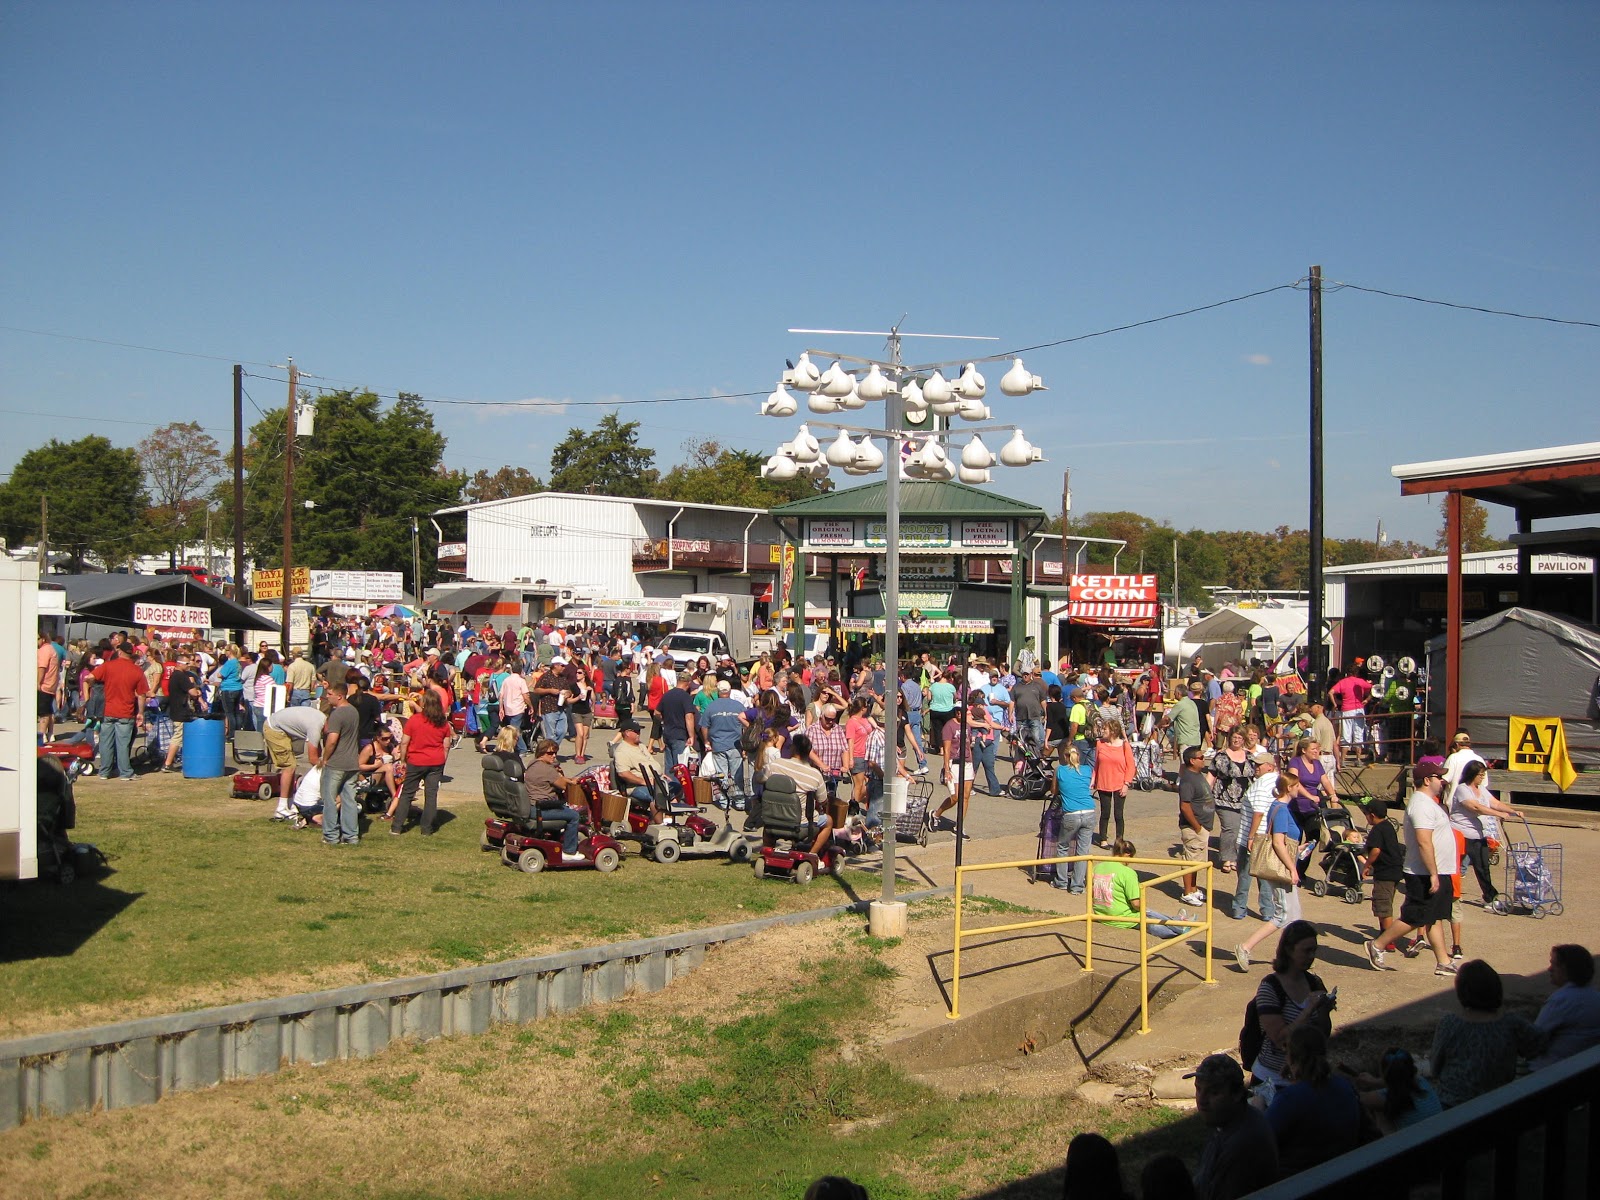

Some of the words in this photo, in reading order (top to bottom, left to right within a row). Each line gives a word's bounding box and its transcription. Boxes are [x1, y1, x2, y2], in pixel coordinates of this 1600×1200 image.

[872, 525, 943, 534] LEMONDE
[1538, 562, 1586, 571] PAVILION
[255, 578, 308, 589] HOME-ADE
[1072, 575, 1154, 587] KETTLE
[276, 587, 305, 596] CAM
[1080, 589, 1147, 600] CORN
[136, 606, 178, 623] BURGERS
[181, 610, 187, 623] &
[189, 610, 209, 624] FRIES
